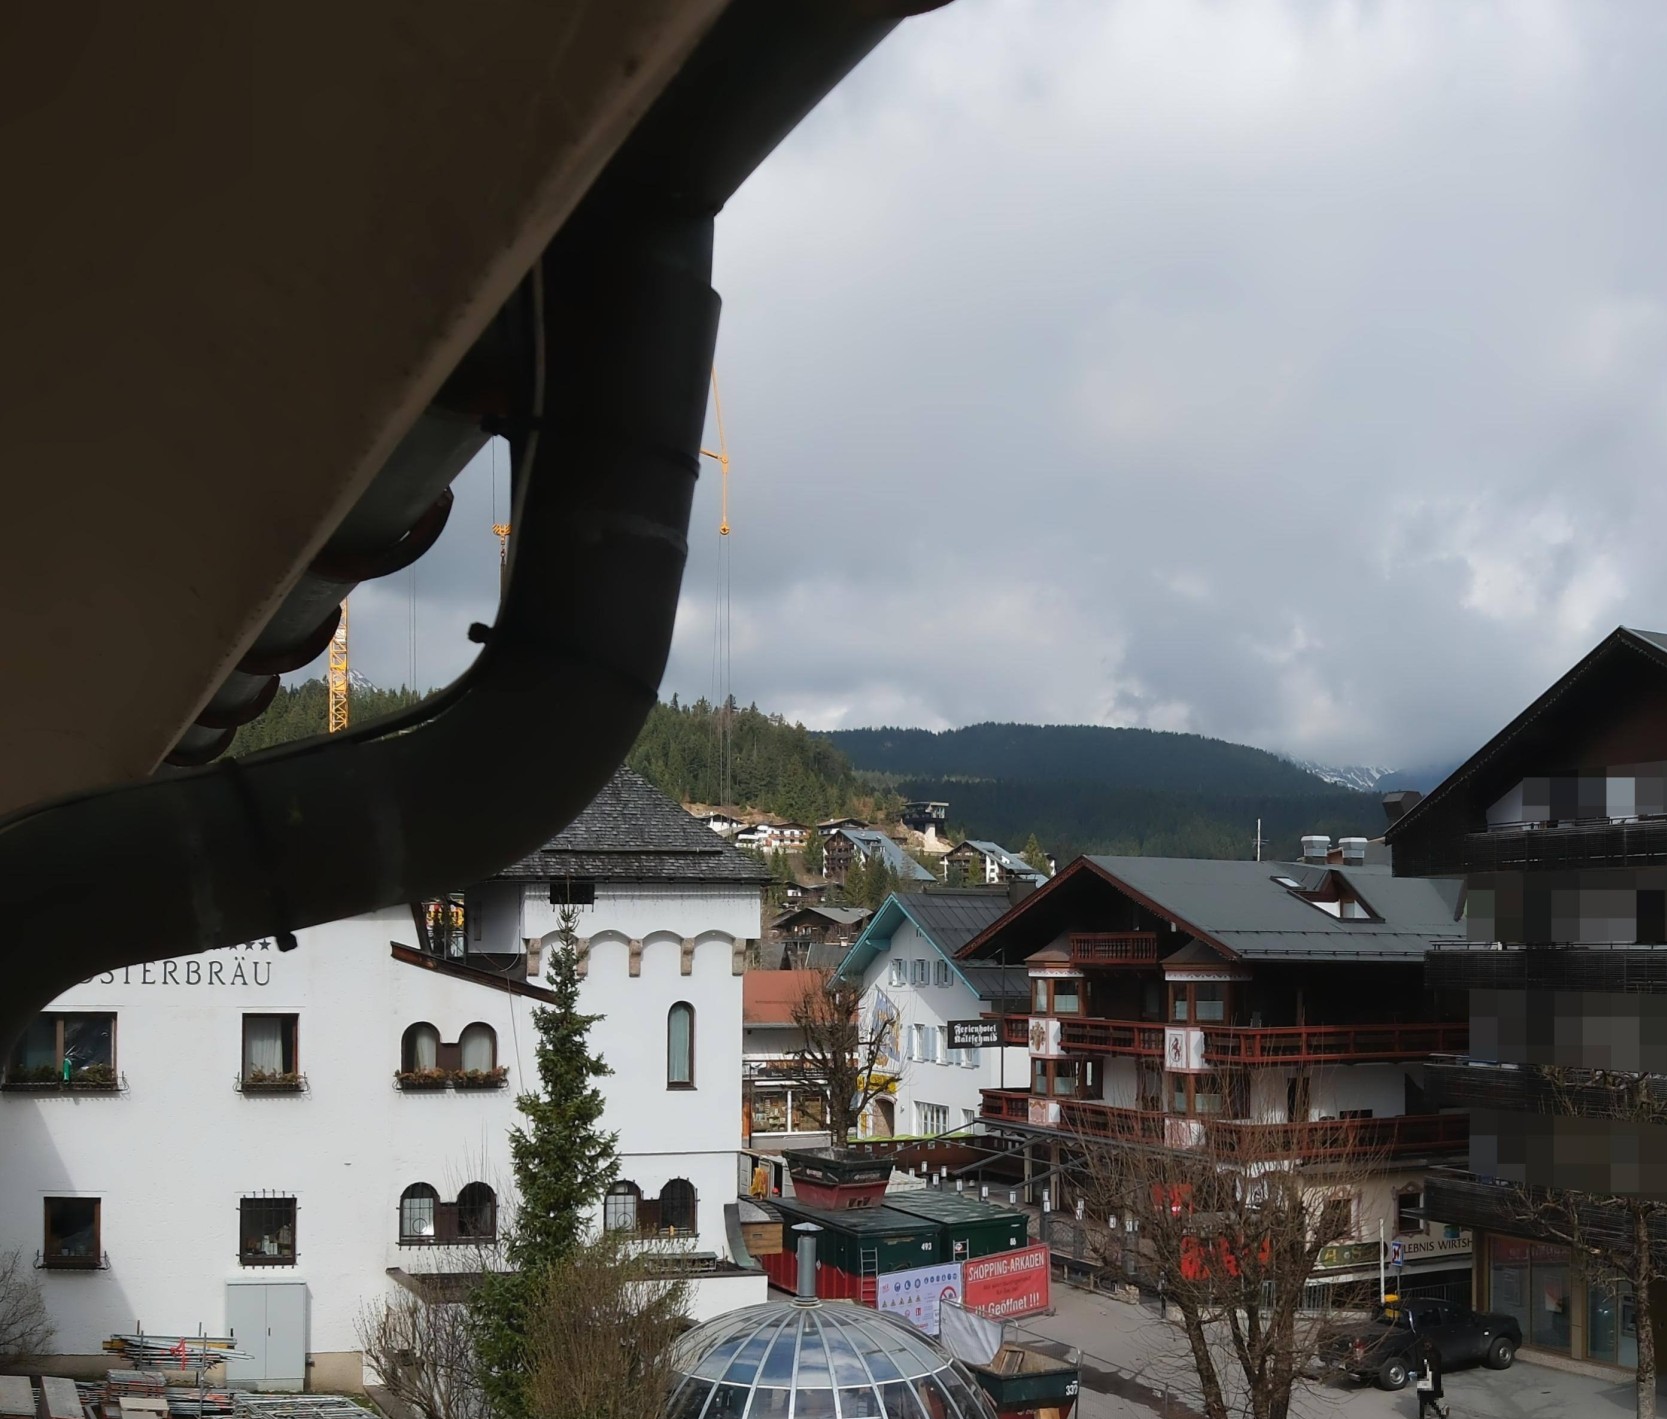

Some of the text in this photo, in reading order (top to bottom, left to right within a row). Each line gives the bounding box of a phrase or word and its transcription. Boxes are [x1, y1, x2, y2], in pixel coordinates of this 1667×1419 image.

[78, 956, 272, 986] STERBRÄU
[921, 1242, 932, 1251] 493
[968, 1252, 1044, 1281] SHOPPING-ARKADEN
